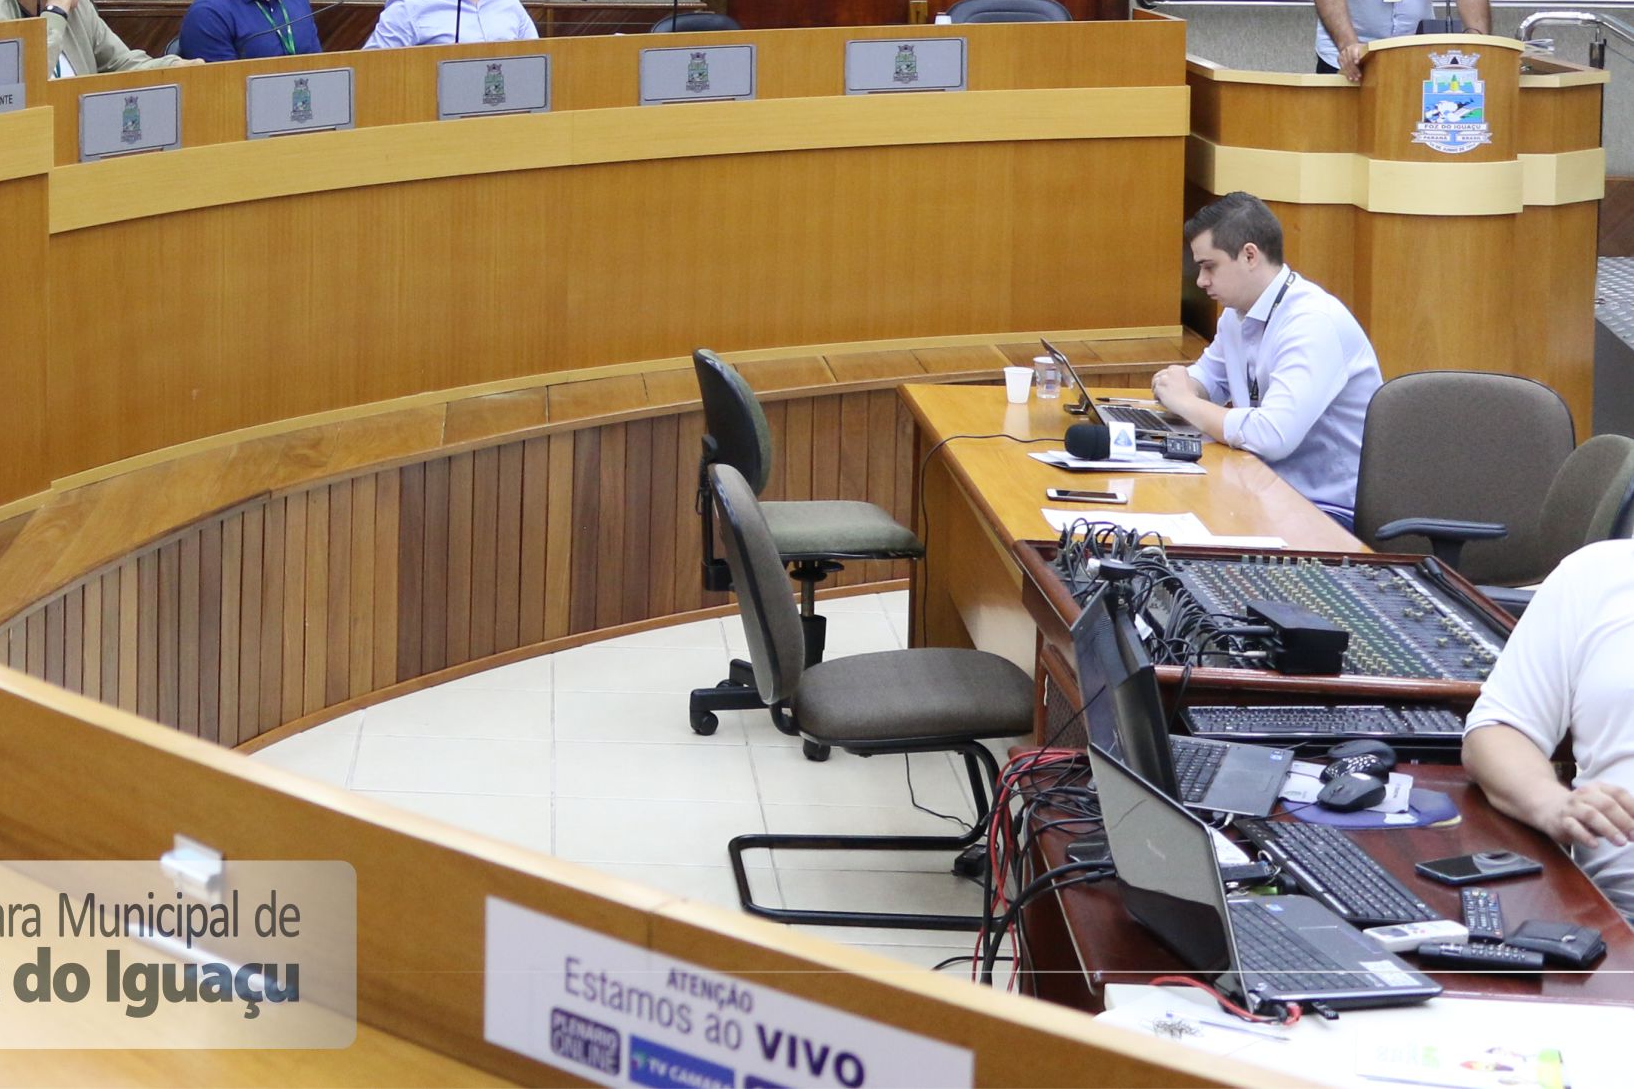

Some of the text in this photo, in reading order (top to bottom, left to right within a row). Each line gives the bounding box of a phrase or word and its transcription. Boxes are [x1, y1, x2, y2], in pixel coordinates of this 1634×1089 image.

[666, 967, 753, 1014] ATENÇÃO
[565, 956, 865, 1089] Estamos ao VIVO
[648, 1058, 667, 1077] TV
